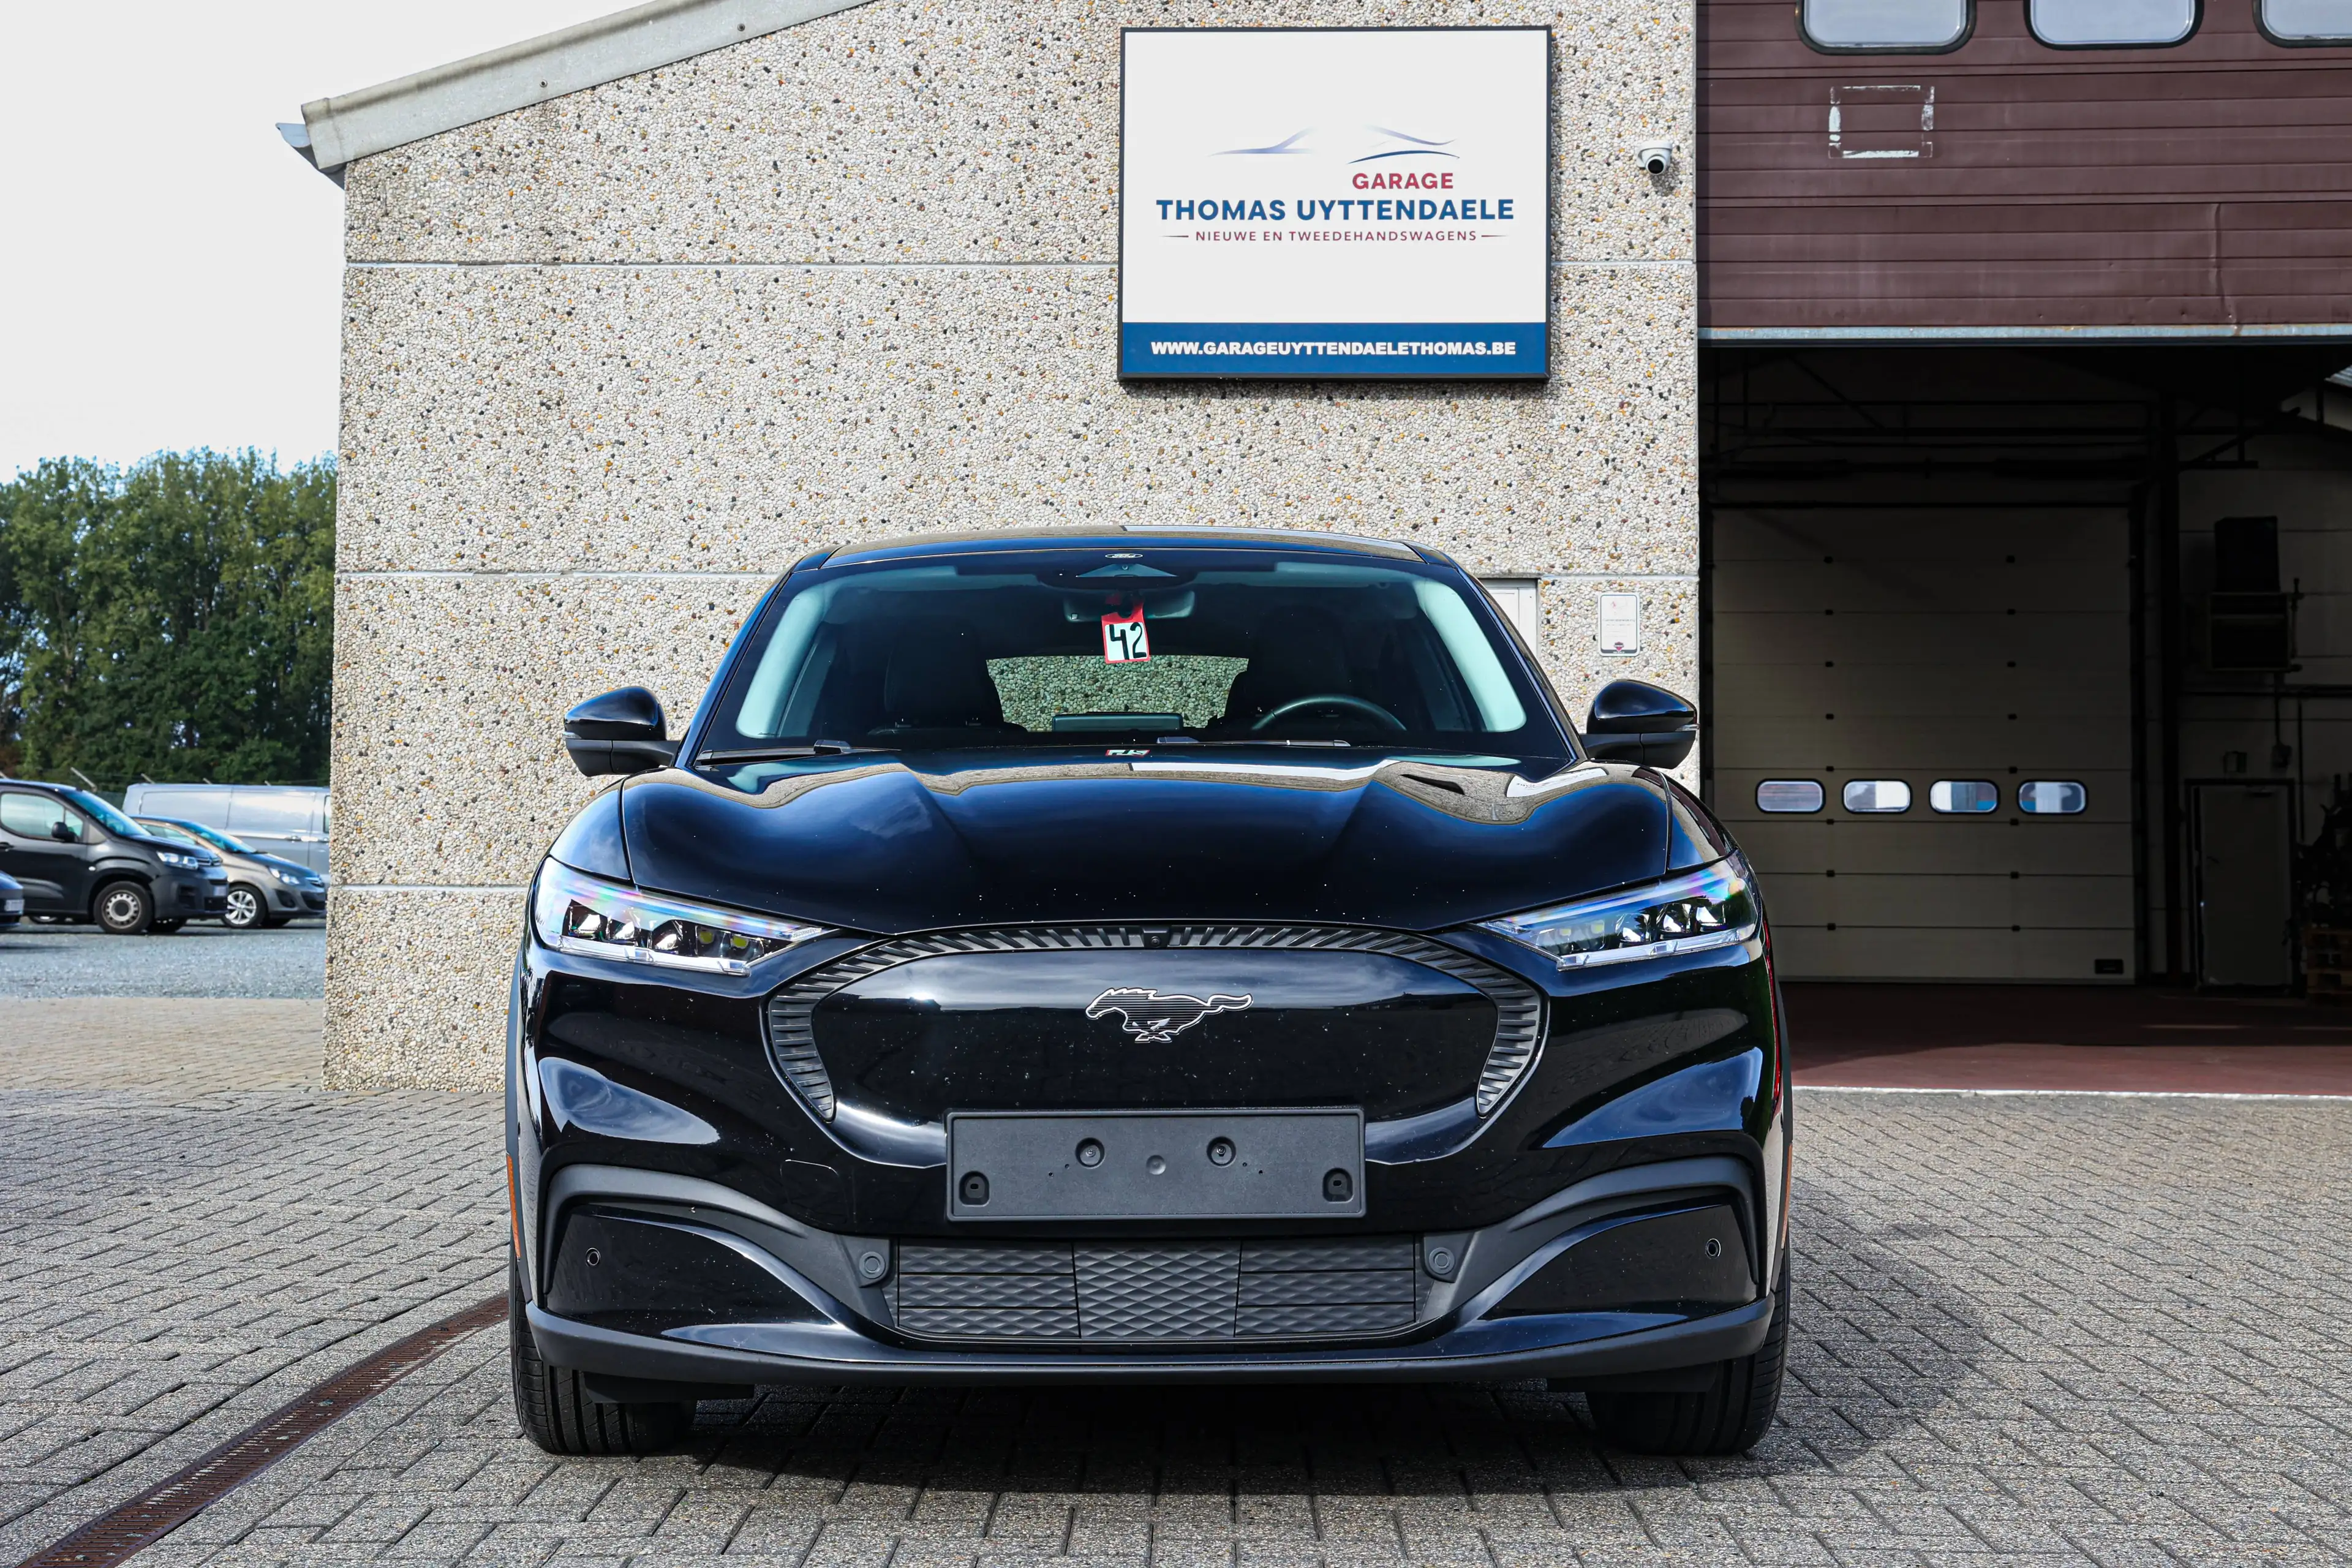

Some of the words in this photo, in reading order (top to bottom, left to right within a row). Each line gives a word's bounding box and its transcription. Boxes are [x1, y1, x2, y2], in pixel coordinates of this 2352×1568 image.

[1352, 173, 1453, 190] GARAGE
[1156, 200, 1285, 221] THOMAS
[1297, 199, 1514, 221] UYTTENDAELE
[1196, 231, 1256, 241] NIEUWE
[1263, 231, 1282, 241] EN
[1289, 230, 1476, 241] TWEEDEHANDSWAGENS
[1151, 342, 1516, 355] WWW.GARAGEUYTTENDAELETHOMAS.BE
[1109, 622, 1147, 660] 42
